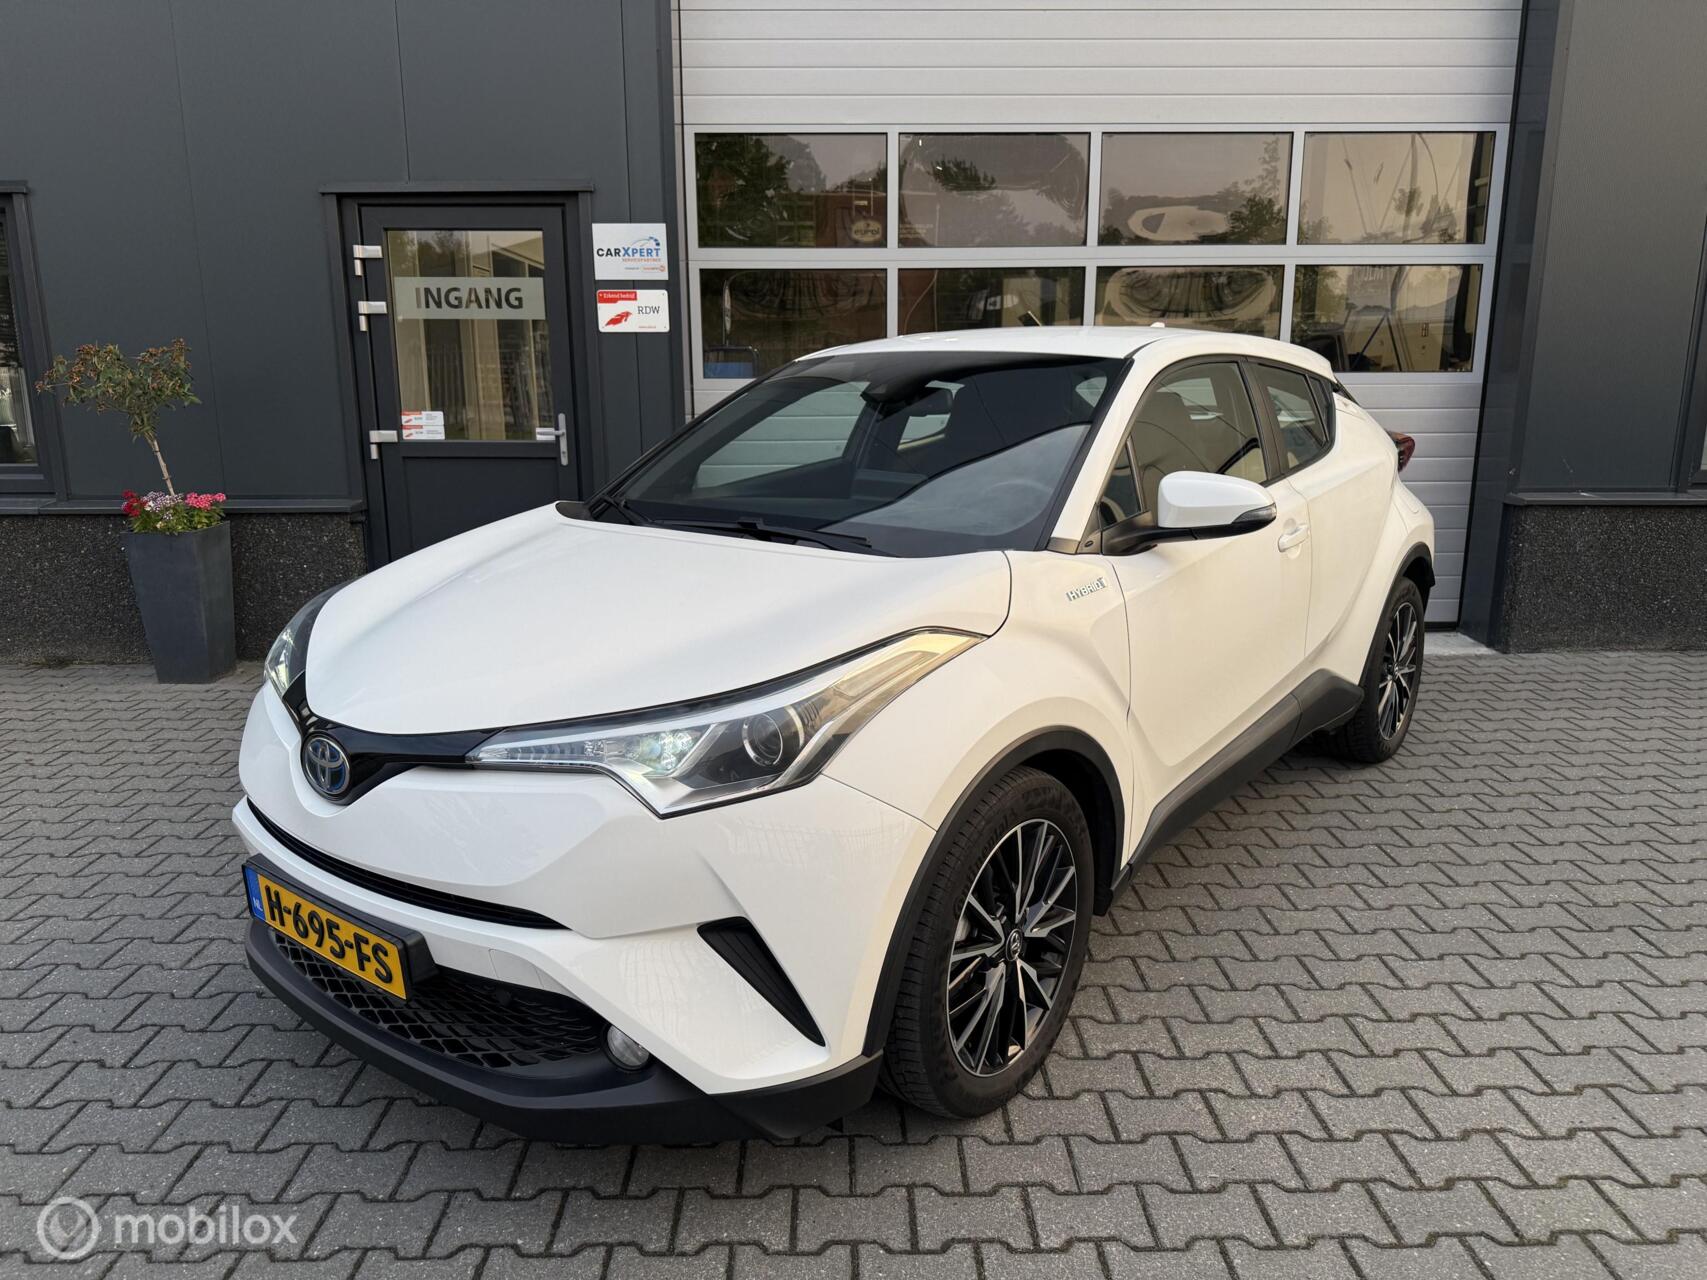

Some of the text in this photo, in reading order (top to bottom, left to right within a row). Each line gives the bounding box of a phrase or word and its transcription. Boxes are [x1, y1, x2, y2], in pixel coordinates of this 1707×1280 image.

[596, 247, 661, 257] CARXPERT
[415, 287, 524, 309] INGANG
[637, 306, 661, 315] RDW
[252, 896, 264, 912] NL
[264, 885, 393, 984] H-695-FS
